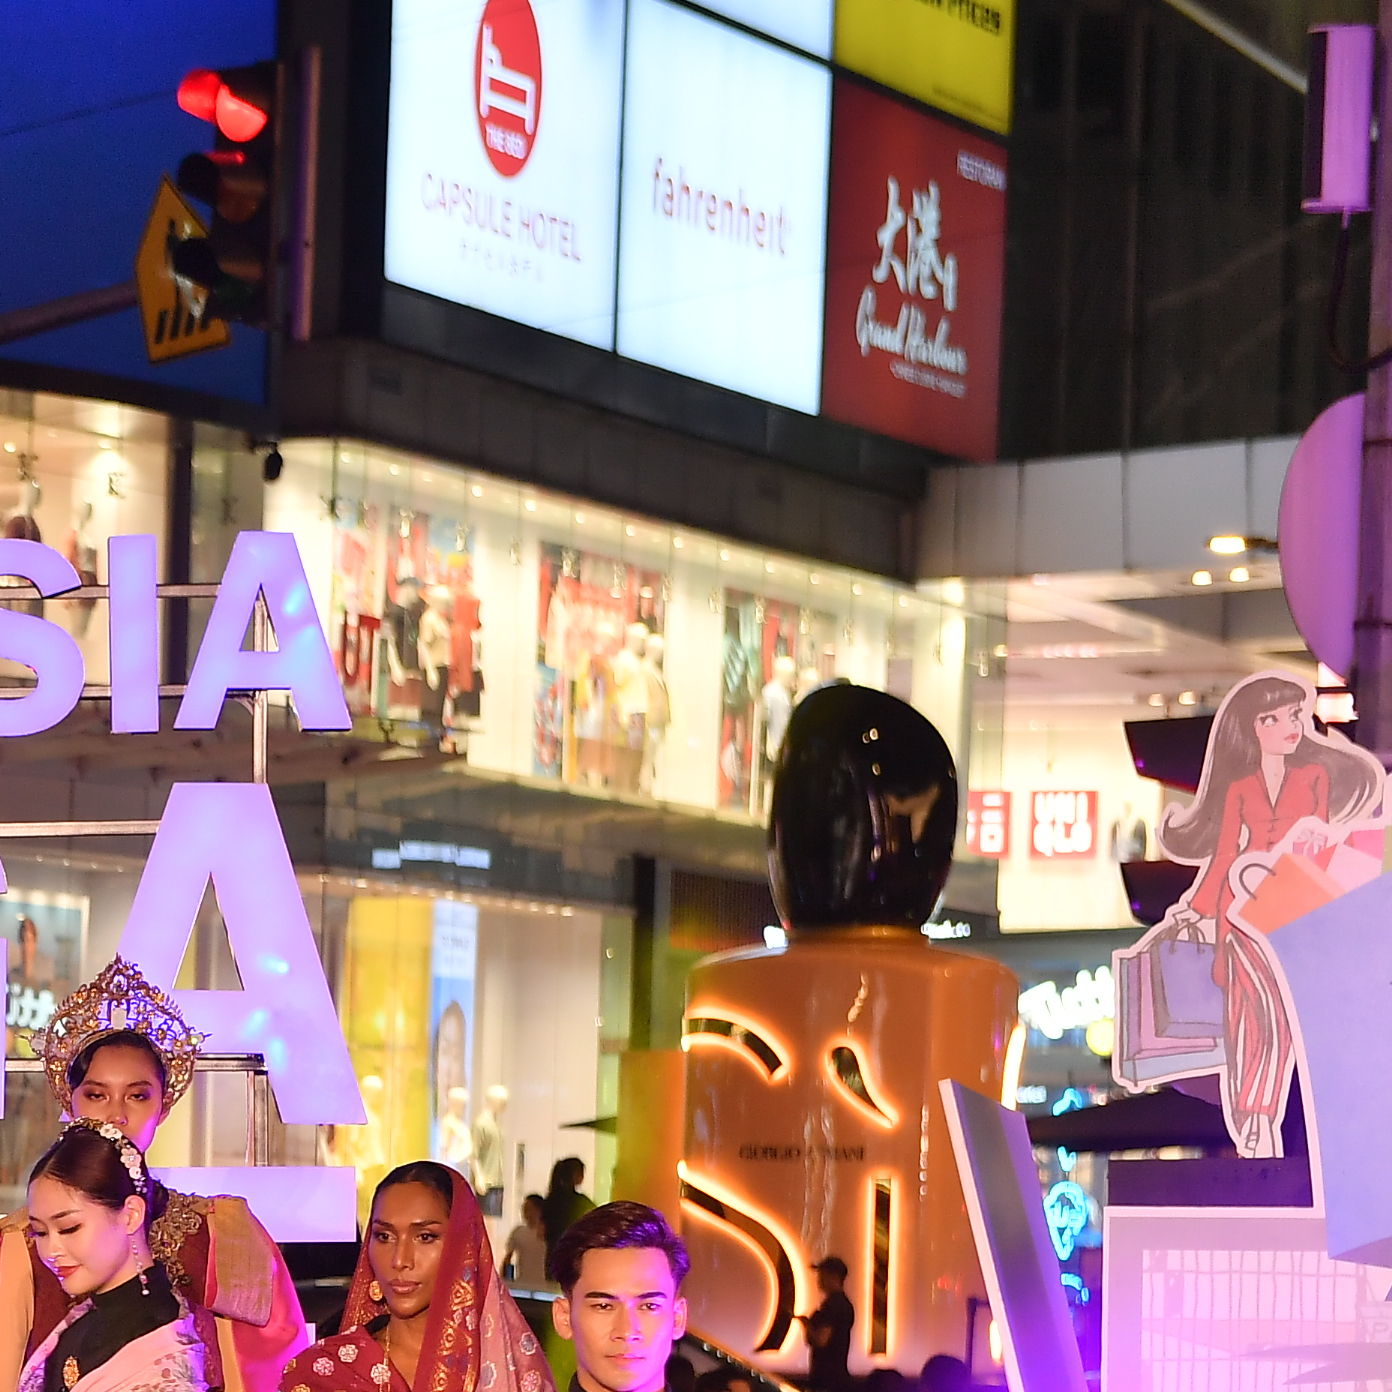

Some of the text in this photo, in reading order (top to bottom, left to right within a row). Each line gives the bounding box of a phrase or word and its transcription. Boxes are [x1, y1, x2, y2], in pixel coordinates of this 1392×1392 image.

[419, 172, 582, 262] CAPSULE HOTEL
[650, 157, 788, 257] fahrenheit
[1032, 821, 1093, 858] QLO
[1033, 792, 1089, 825] UNI
